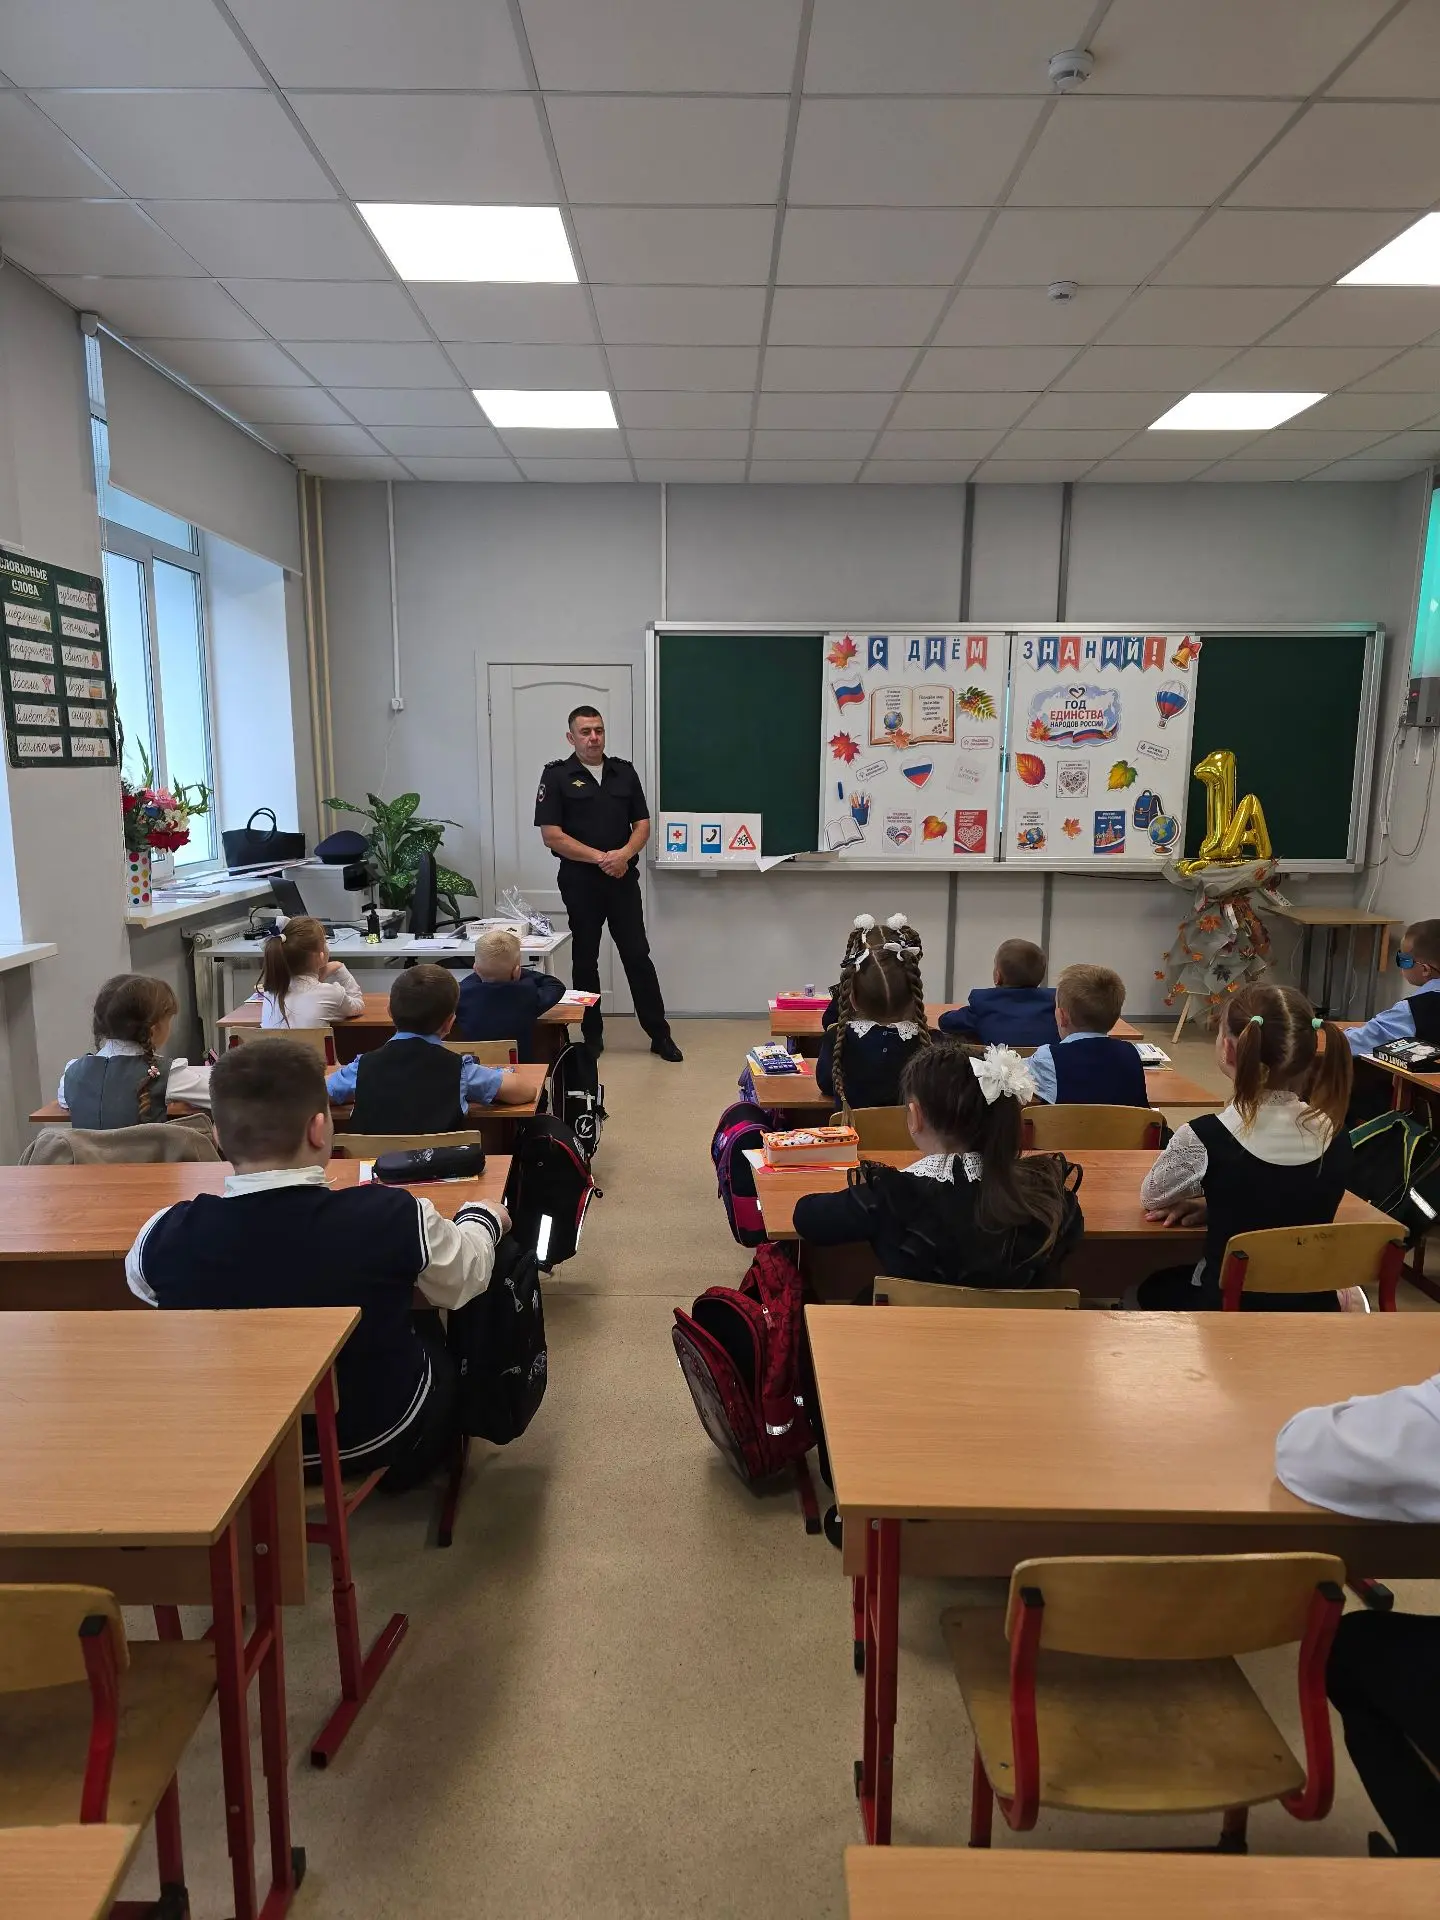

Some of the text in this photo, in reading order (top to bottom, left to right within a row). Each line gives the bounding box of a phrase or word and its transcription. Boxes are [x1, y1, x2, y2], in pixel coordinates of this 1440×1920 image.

[0, 557, 47, 580] СЛОВАРНЫЕ
[12, 579, 39, 596] СЛОВА
[872, 638, 983, 661] С ДНЁМ
[1023, 637, 1159, 661] ЗНАНИЙ!
[1065, 700, 1086, 710] ГОД
[1051, 710, 1104, 721] ЕДИНСТВА
